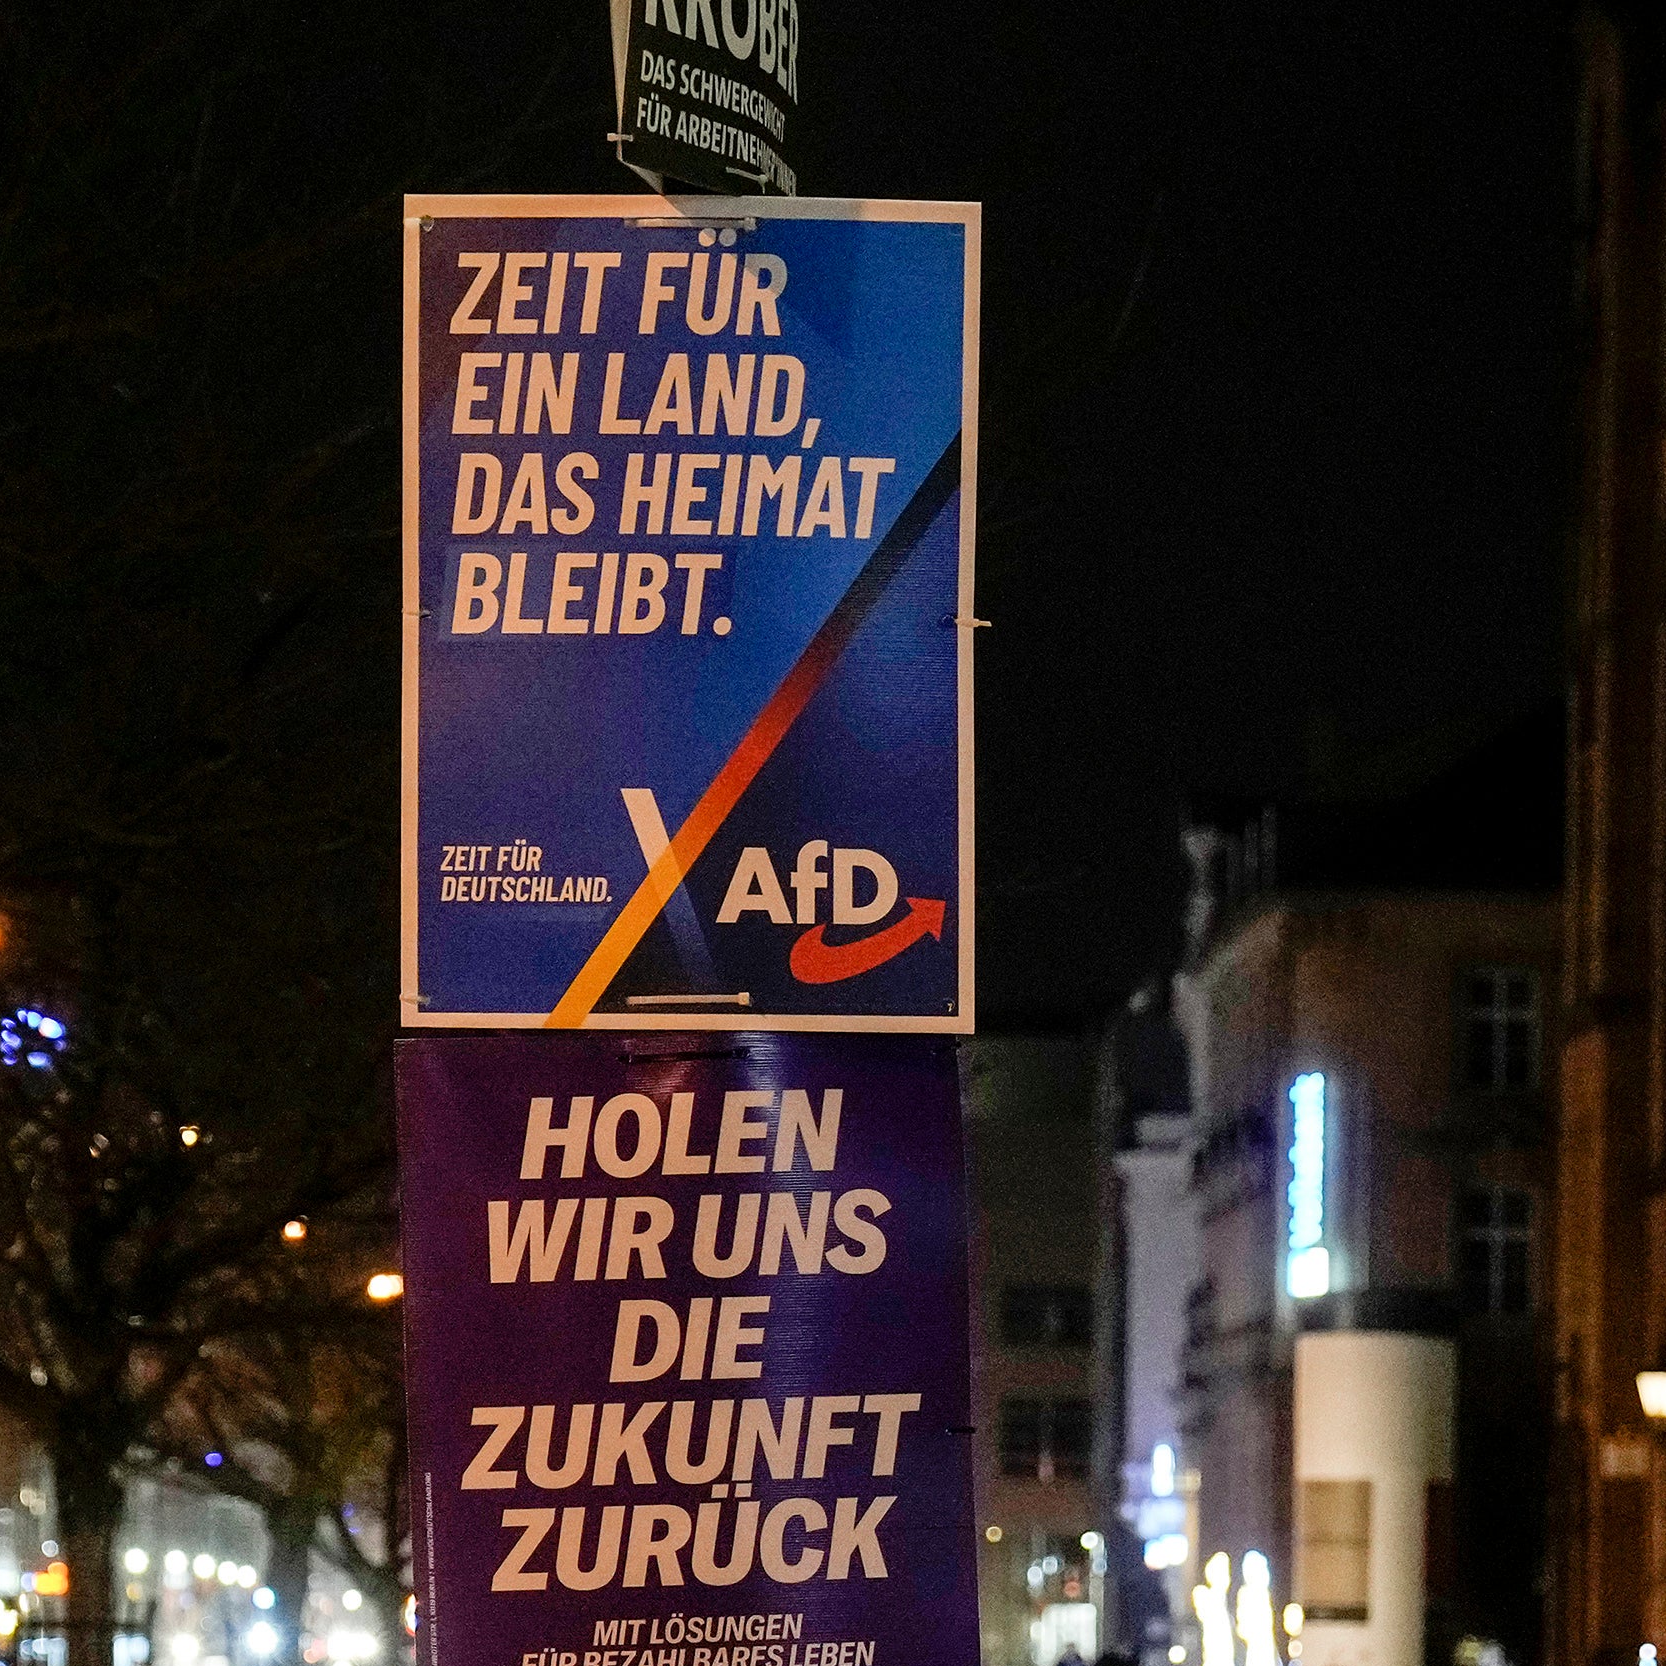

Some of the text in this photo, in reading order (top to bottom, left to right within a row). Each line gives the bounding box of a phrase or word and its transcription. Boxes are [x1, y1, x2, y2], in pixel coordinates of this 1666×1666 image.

[640, 50, 786, 143] DAS SCHWERGEWICHT
[645, 0, 799, 105] BER
[636, 92, 672, 138] FÜR
[450, 228, 788, 337] ZEIT FÜR
[452, 353, 820, 448] EIN LAND,
[452, 452, 895, 539] DAS HEIMAT
[451, 553, 731, 635] BLEIBT.
[441, 839, 542, 872] ZEIT FÜR
[441, 877, 613, 903] DEUTSCHLAND.
[715, 839, 900, 925] AfD
[520, 1089, 843, 1180] HOLEN
[488, 1189, 891, 1283] WIR UNS
[610, 1296, 771, 1383] DIE
[461, 1394, 921, 1490] ZUKUNFT
[491, 1484, 897, 1591] ZURÜCK
[593, 1613, 804, 1646] MIT LÖSUNGEN
